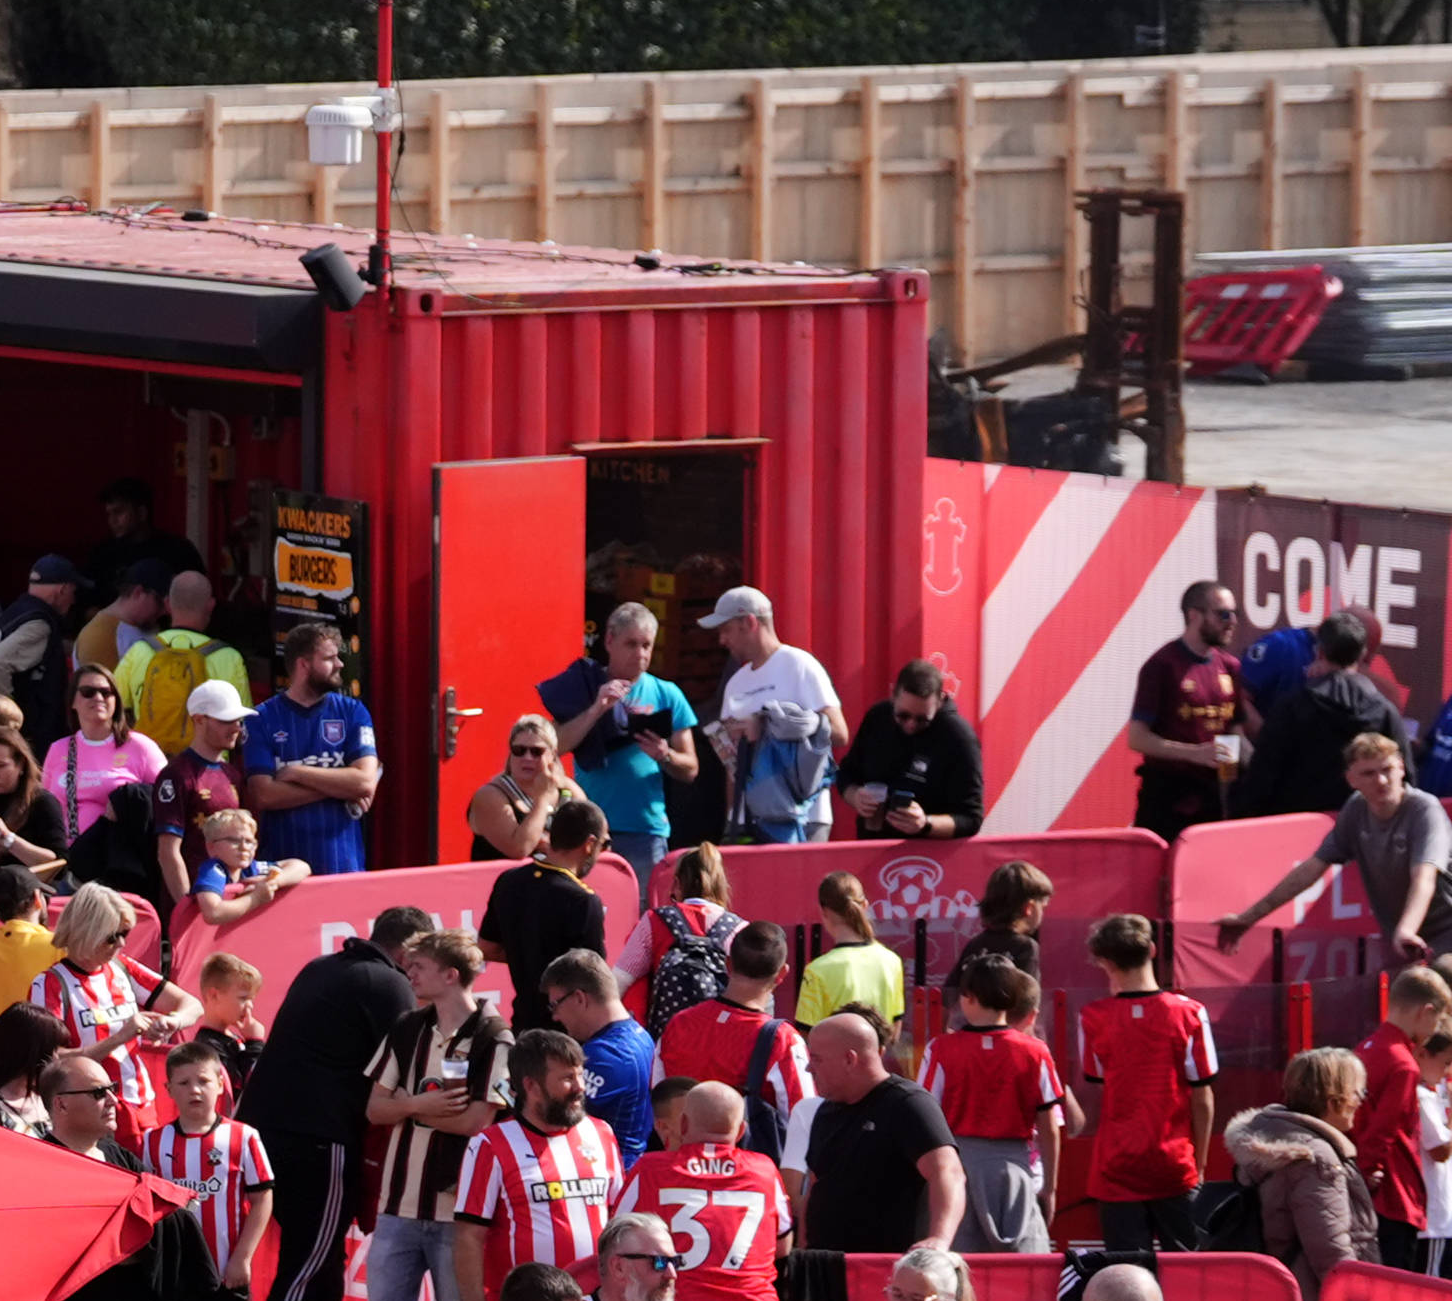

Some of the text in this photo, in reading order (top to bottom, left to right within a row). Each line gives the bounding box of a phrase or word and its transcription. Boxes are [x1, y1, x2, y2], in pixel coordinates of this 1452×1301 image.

[590, 459, 671, 484] KITCHEN
[277, 505, 352, 539] KWACKERS
[289, 553, 338, 586] BURGERS
[1243, 530, 1422, 649] COME
[581, 1068, 605, 1086] ALO
[533, 1177, 607, 1202] ROLLBIT
[658, 1186, 766, 1272] 37
